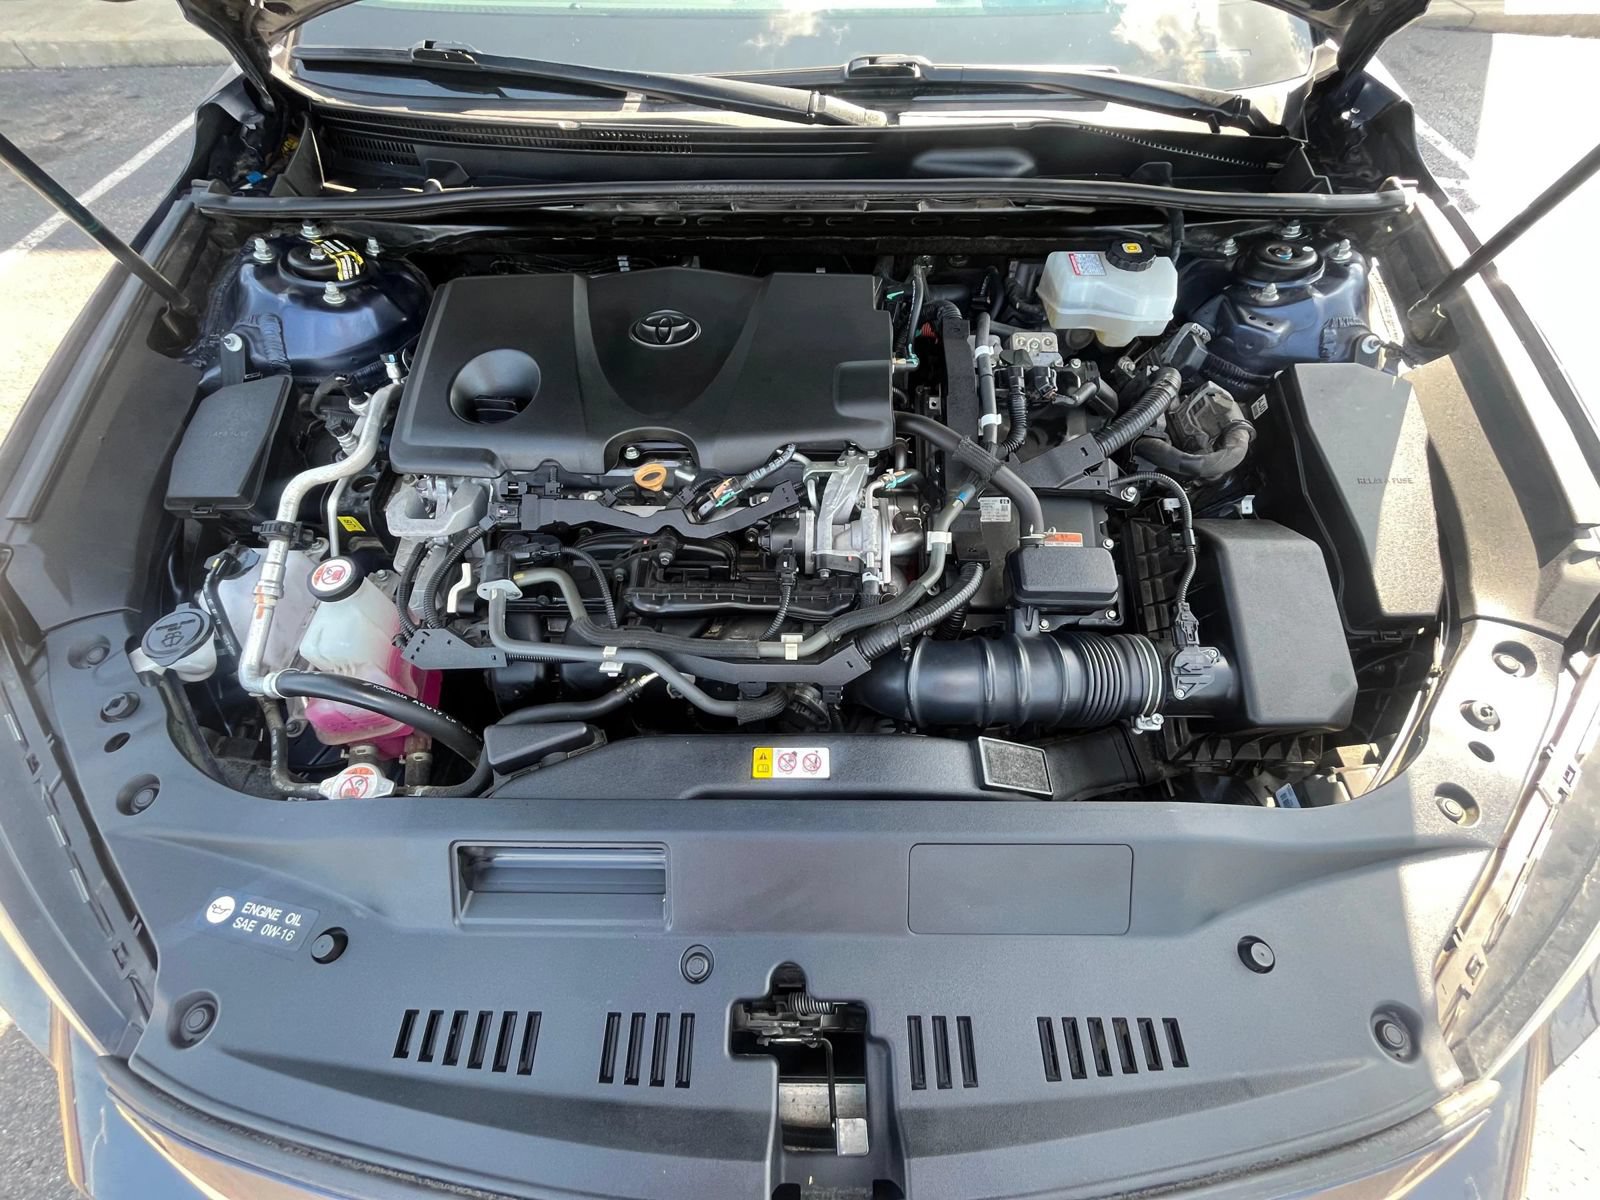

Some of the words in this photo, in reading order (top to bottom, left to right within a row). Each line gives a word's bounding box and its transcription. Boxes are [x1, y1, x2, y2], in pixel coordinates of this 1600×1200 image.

[241, 902, 283, 921] ENGINE
[285, 912, 302, 926] OIL
[232, 916, 258, 932] SAE
[261, 923, 295, 941] 0W-16
